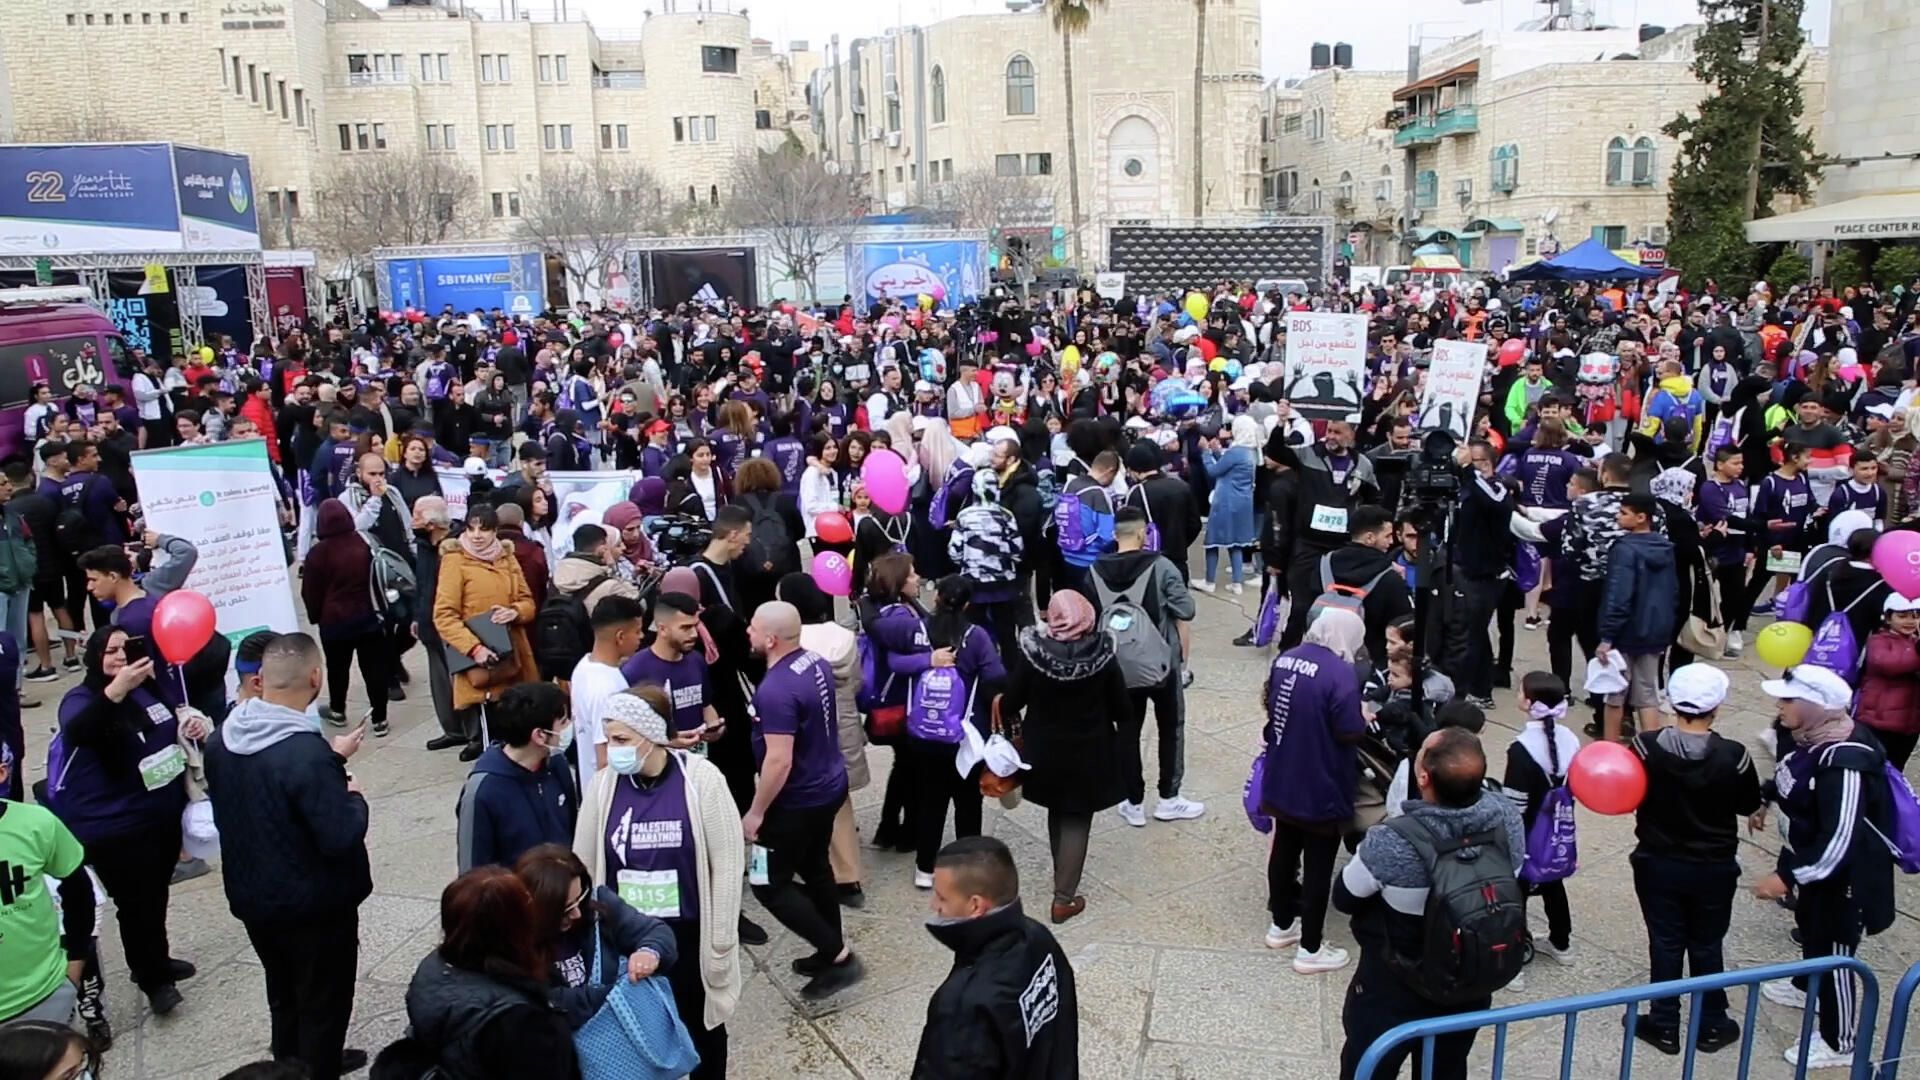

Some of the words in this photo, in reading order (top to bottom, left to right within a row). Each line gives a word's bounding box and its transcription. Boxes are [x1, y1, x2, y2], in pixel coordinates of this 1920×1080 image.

[26, 171, 66, 202] 22
[1834, 223, 1865, 234] PEACE
[1867, 222, 1909, 233] CENTER
[437, 273, 492, 286] SBITANY
[1292, 319, 1312, 332] BDS
[1527, 454, 1545, 463] RUN
[1545, 455, 1563, 466] FOR
[914, 631, 931, 647] RU
[1293, 658, 1319, 678] FOR
[631, 820, 683, 833] PALESTINE
[631, 831, 683, 844] MARATHON
